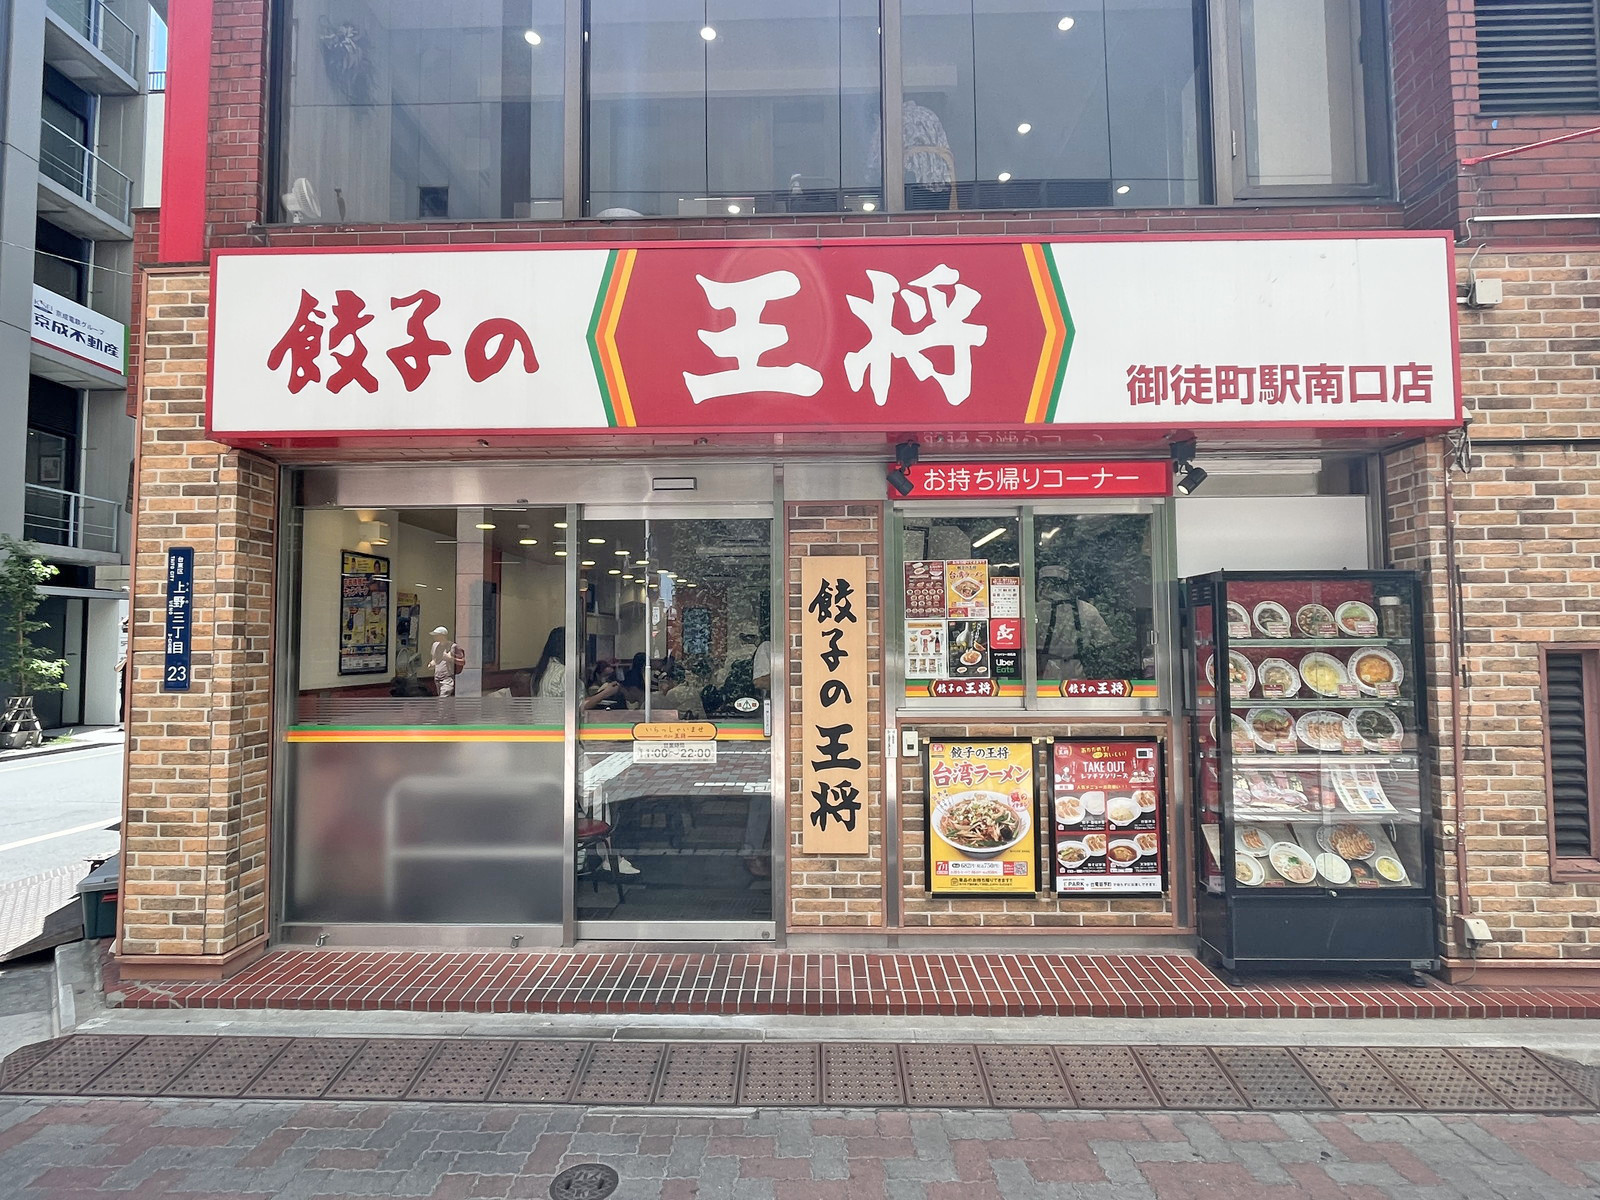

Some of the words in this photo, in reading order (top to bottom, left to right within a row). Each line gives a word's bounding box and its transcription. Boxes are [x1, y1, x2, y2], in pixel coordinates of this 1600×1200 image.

[33, 312, 120, 359] 京成不動産
[266, 288, 540, 394] 餃子の
[682, 263, 988, 406] 王将
[1126, 362, 1434, 405] 御徒町駅南口店
[923, 467, 1140, 492] お持ち帰りコーナー
[172, 580, 186, 654] 上野三丁目
[996, 658, 1014, 667] Uber
[996, 666, 1015, 674] Eats
[167, 666, 187, 682] 23
[936, 682, 991, 695] 餃子の王将
[1067, 682, 1125, 695] 餃子の王将
[808, 577, 862, 833] 餃子の王将
[950, 746, 1009, 759] 餃子の王将
[932, 761, 1030, 787] 台湾ラーメン
[1083, 761, 1106, 773] TAKE
[1106, 761, 1126, 773] OUT
